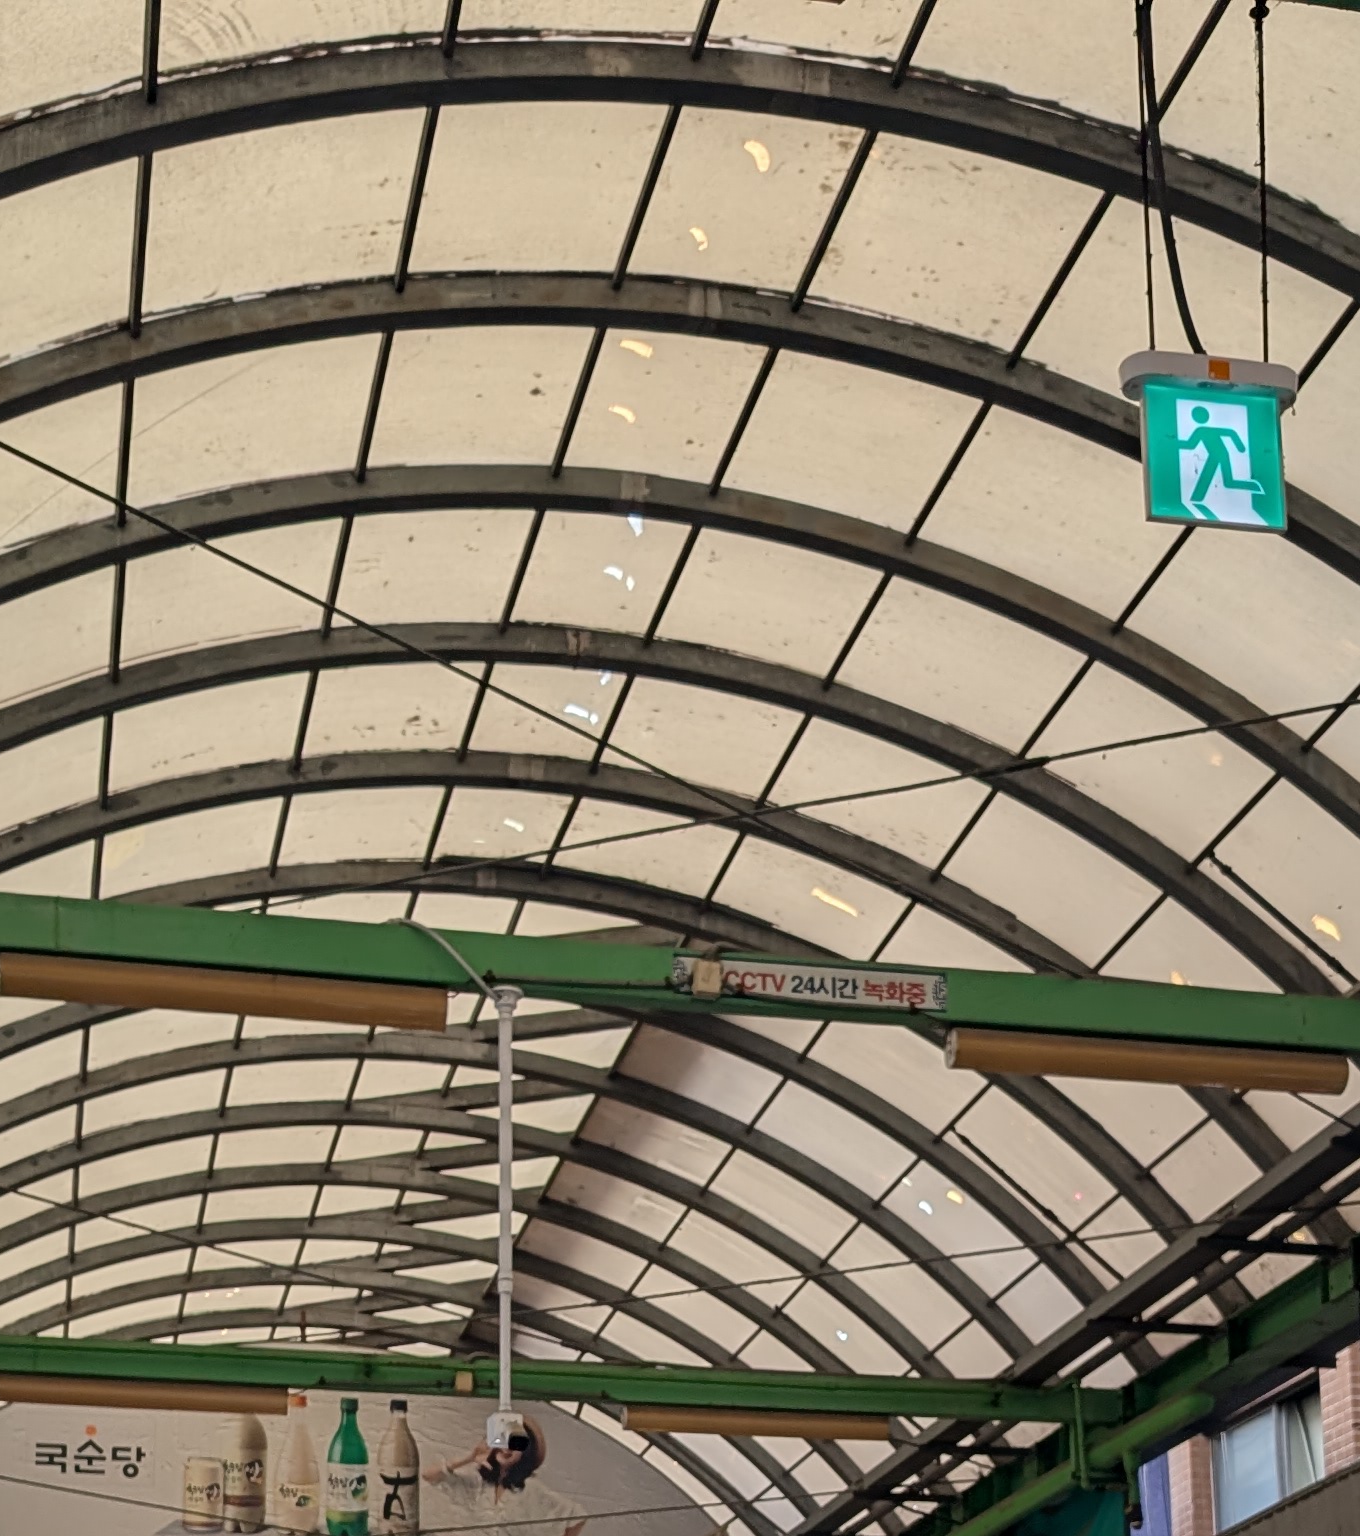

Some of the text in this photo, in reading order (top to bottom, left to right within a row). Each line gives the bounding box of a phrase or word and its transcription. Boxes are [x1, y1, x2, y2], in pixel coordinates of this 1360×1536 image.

[725, 970, 786, 995] CCTV
[791, 975, 858, 1000] 24시간
[34, 1434, 146, 1479] 국순당
